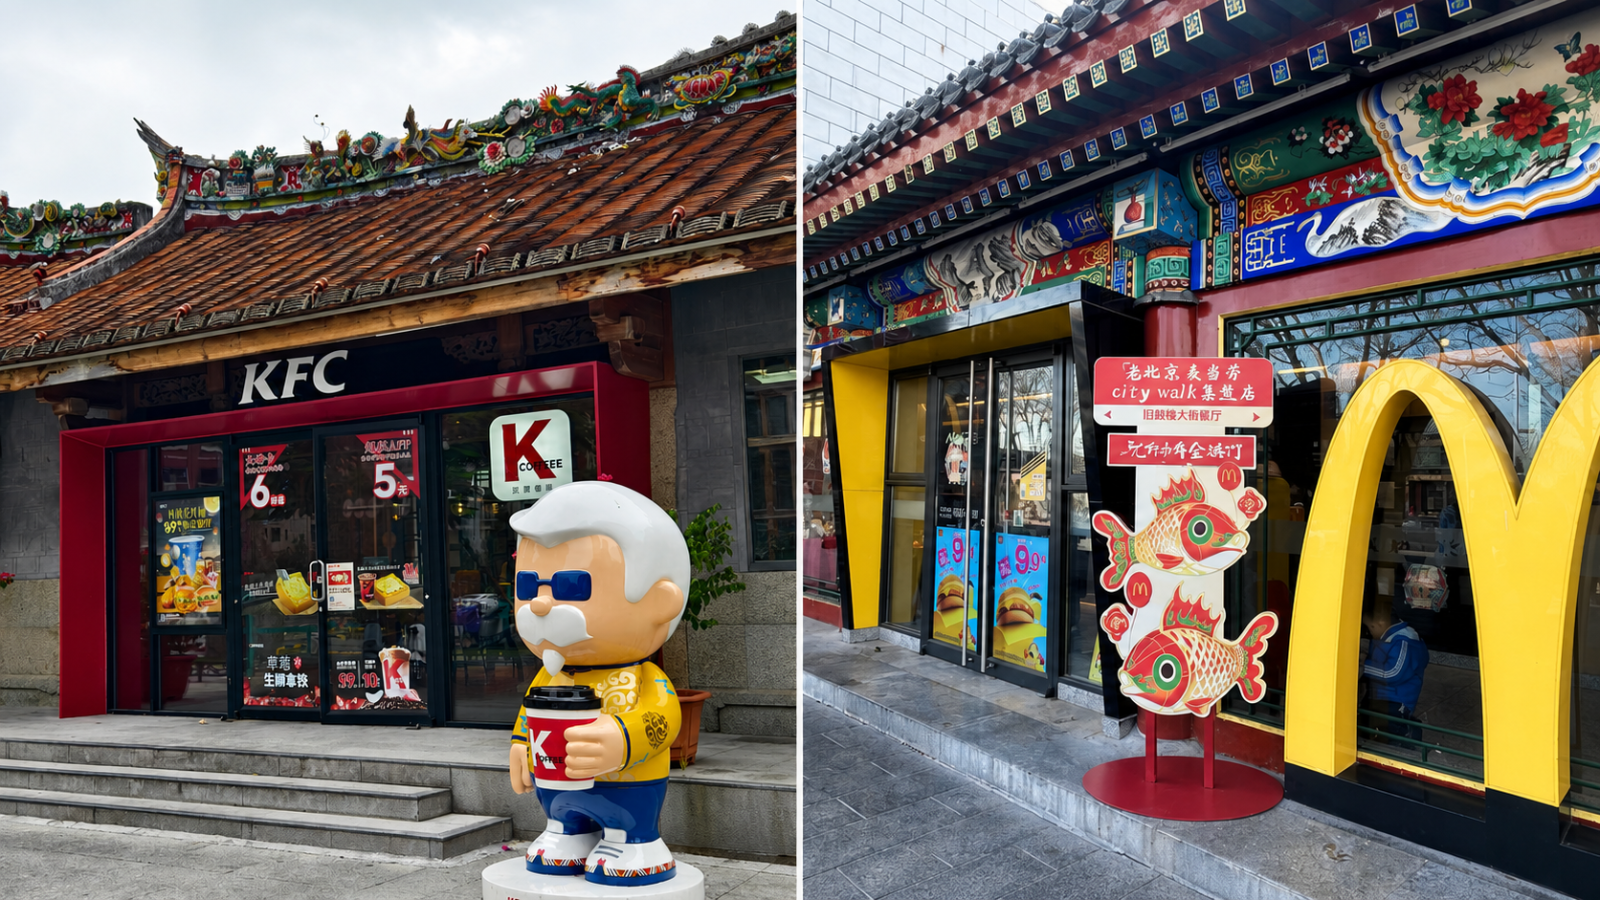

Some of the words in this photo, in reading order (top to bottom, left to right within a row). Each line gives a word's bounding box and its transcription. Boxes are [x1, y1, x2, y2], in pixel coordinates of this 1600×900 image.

[238, 350, 349, 405] KFC
[1112, 384, 1150, 403] city
[1158, 383, 1197, 399] walk
[501, 418, 557, 483] K
[250, 473, 271, 508] 6
[373, 462, 397, 499] 5
